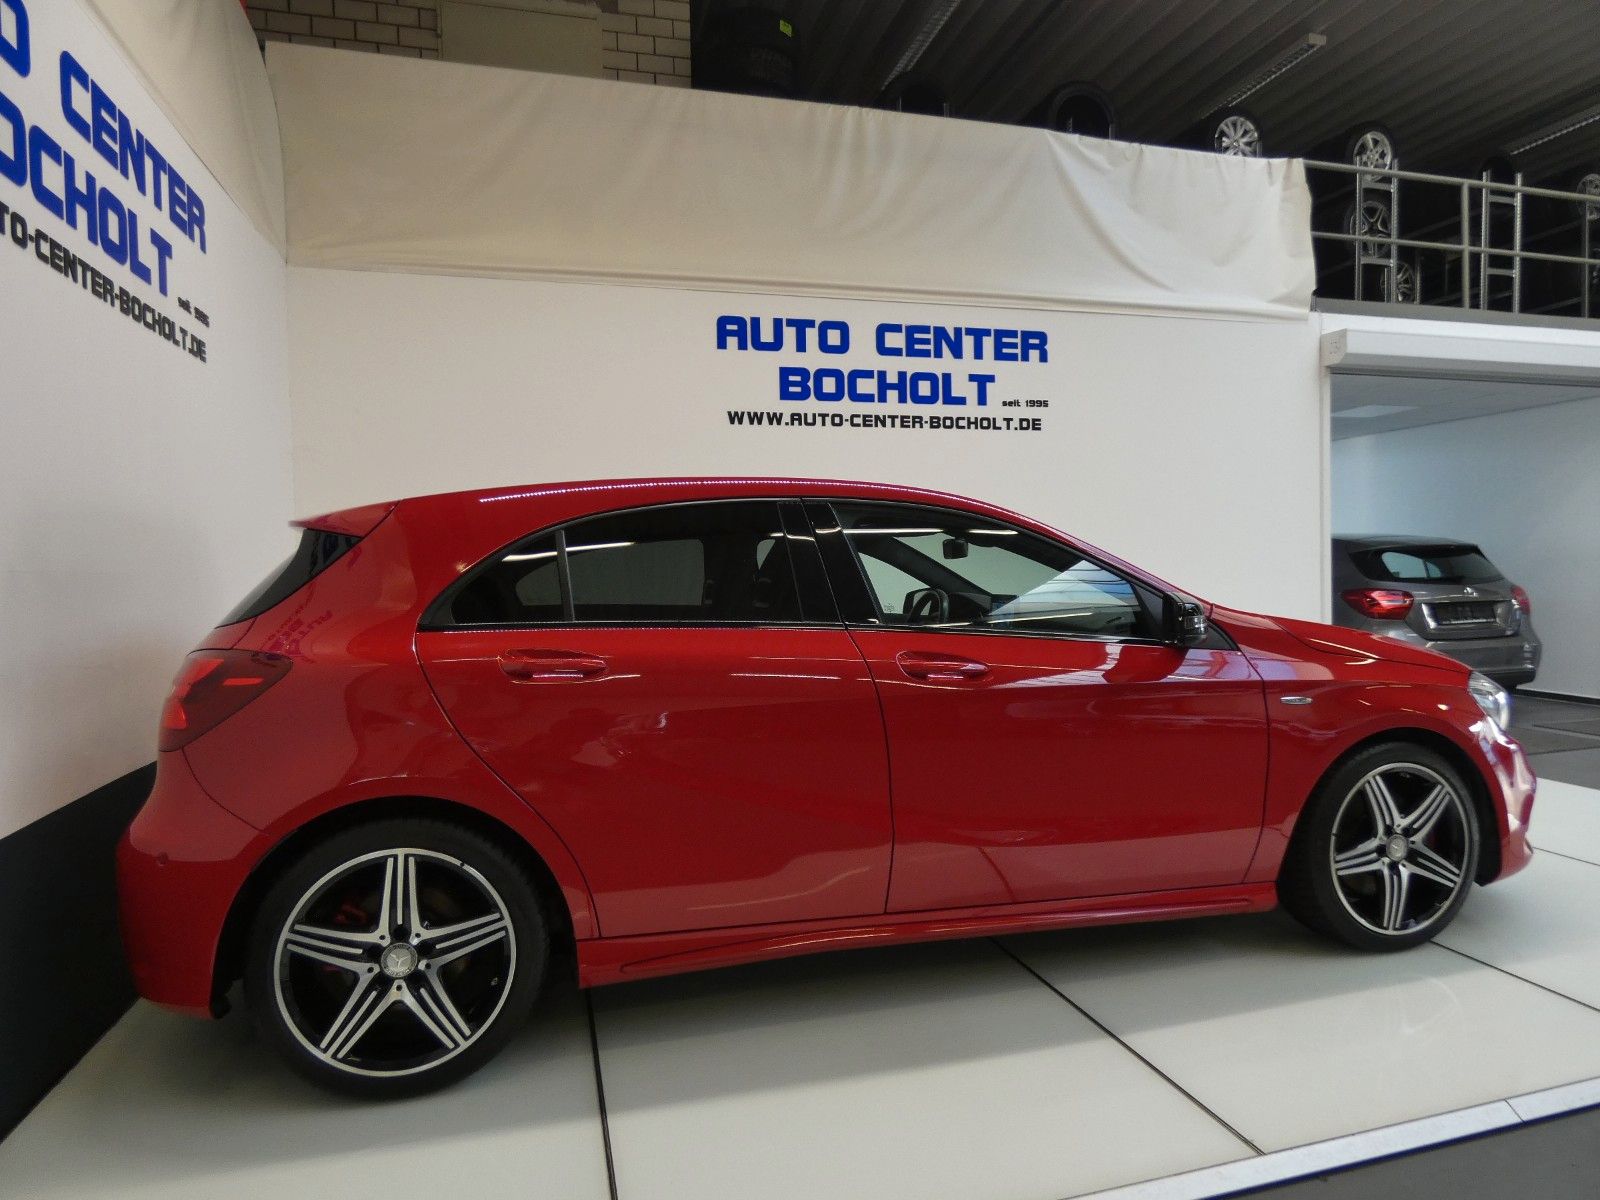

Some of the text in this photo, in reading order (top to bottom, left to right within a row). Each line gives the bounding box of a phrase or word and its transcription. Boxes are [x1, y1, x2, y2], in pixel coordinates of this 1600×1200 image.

[59, 50, 206, 254] CENTER
[716, 315, 1049, 363] AUTO CENTER
[779, 366, 1049, 408] BOCHOLT seit 1995
[727, 410, 1042, 431] WWW.AUTO-CENTER-BOCHOLT.DE
